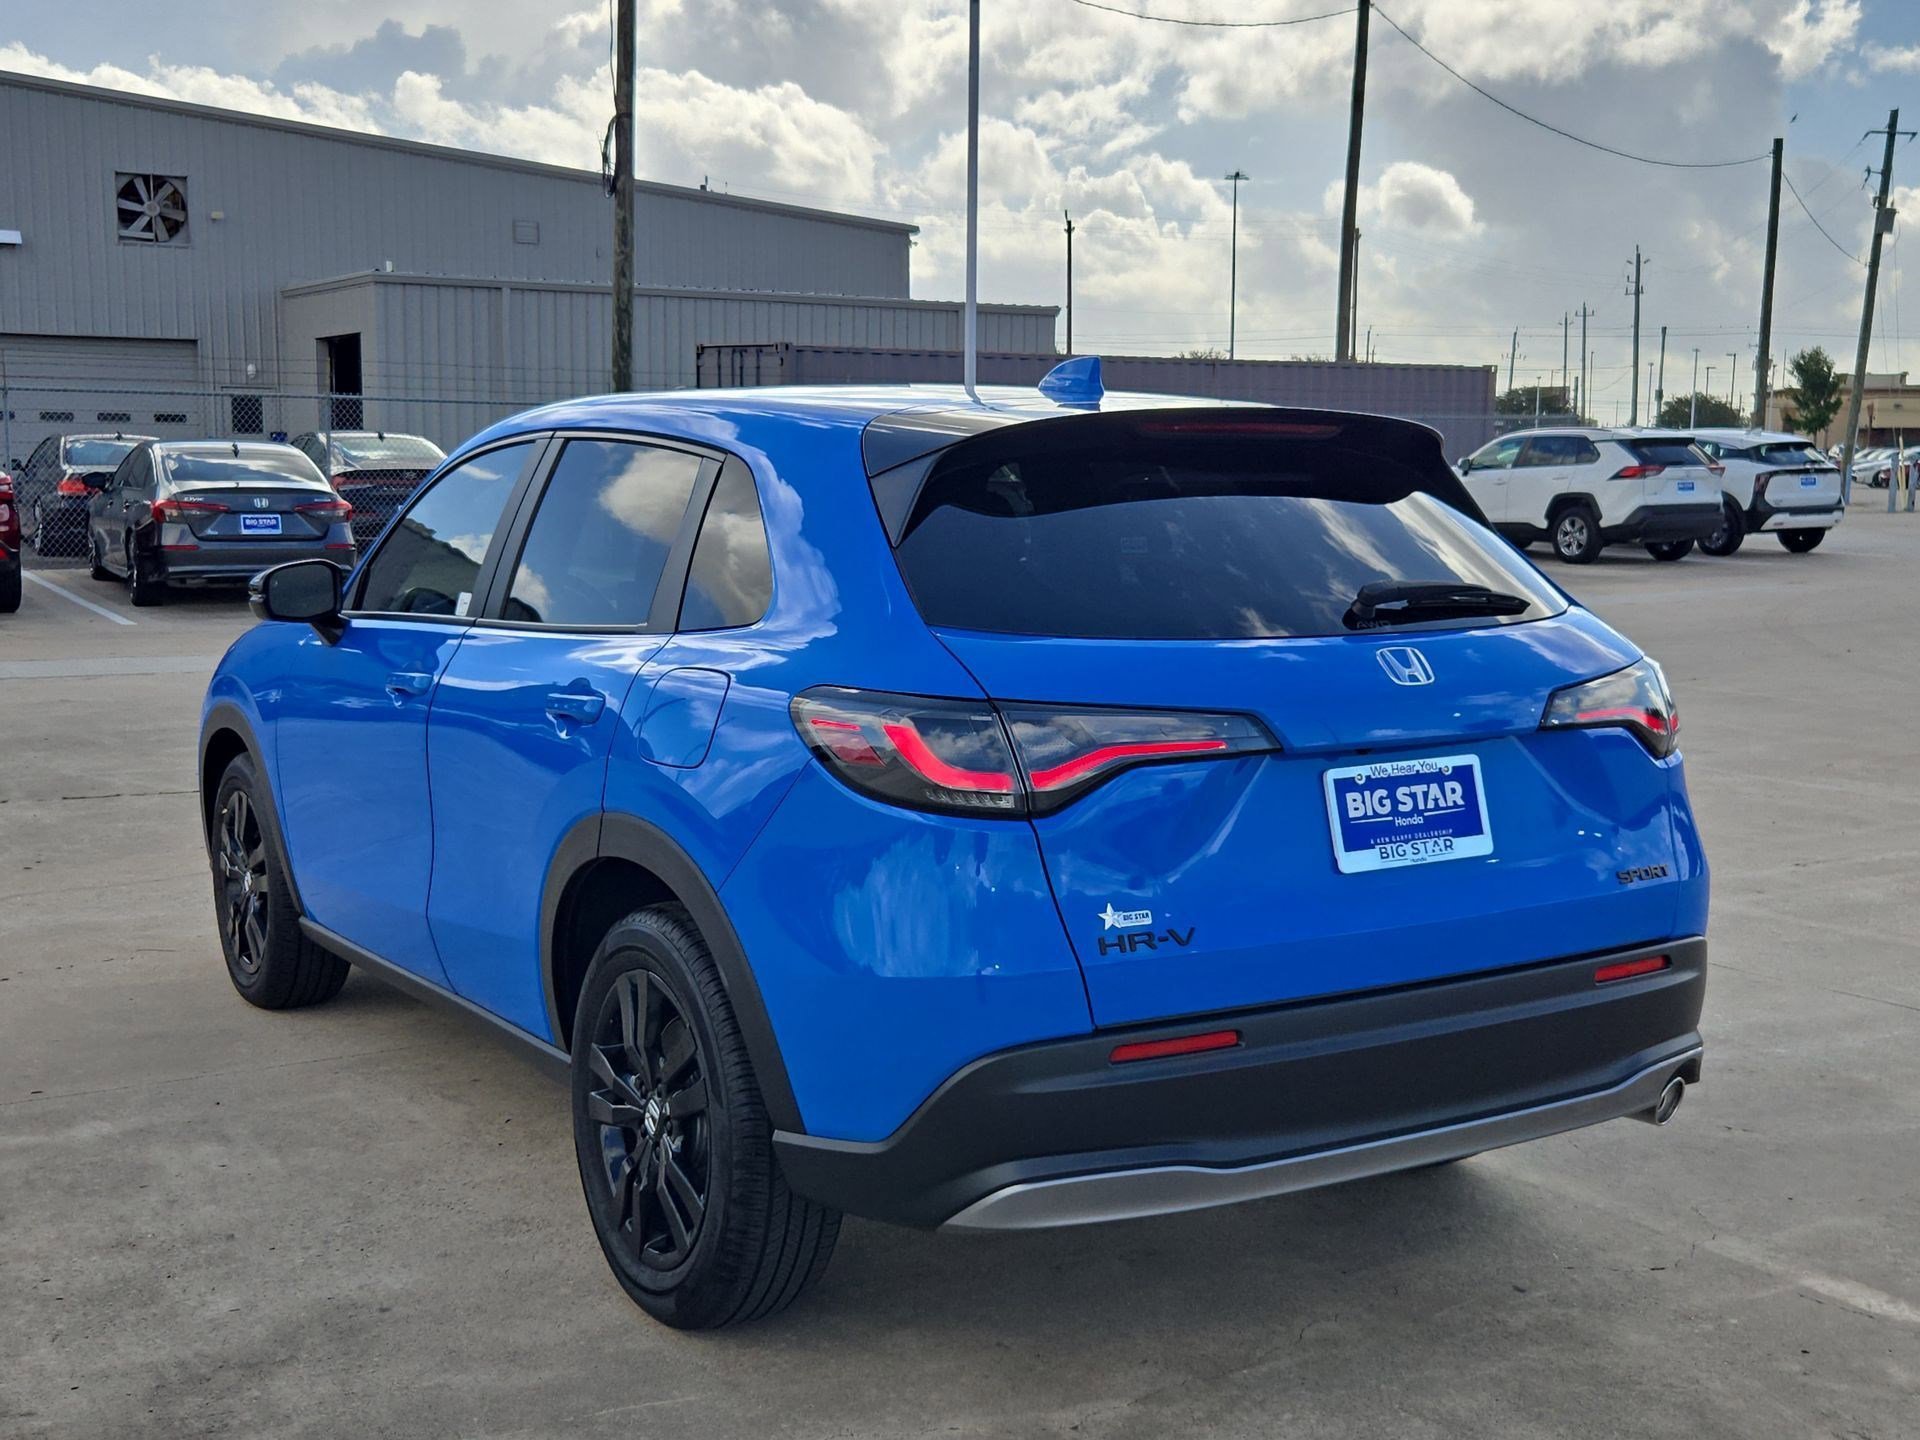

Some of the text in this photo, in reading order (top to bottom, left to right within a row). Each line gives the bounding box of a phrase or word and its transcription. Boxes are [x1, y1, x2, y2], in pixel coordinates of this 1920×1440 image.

[1356, 619, 1392, 630] AWD
[1369, 760, 1438, 777] We Hear You
[1345, 781, 1465, 818] BIG STAR
[1394, 813, 1424, 827] Honda
[1414, 828, 1453, 840] DEALERSHIP
[1378, 838, 1454, 860] BIG STAR
[1616, 864, 1669, 885] SPORT
[1134, 912, 1150, 920] STAR
[1097, 926, 1196, 956] HR-V
